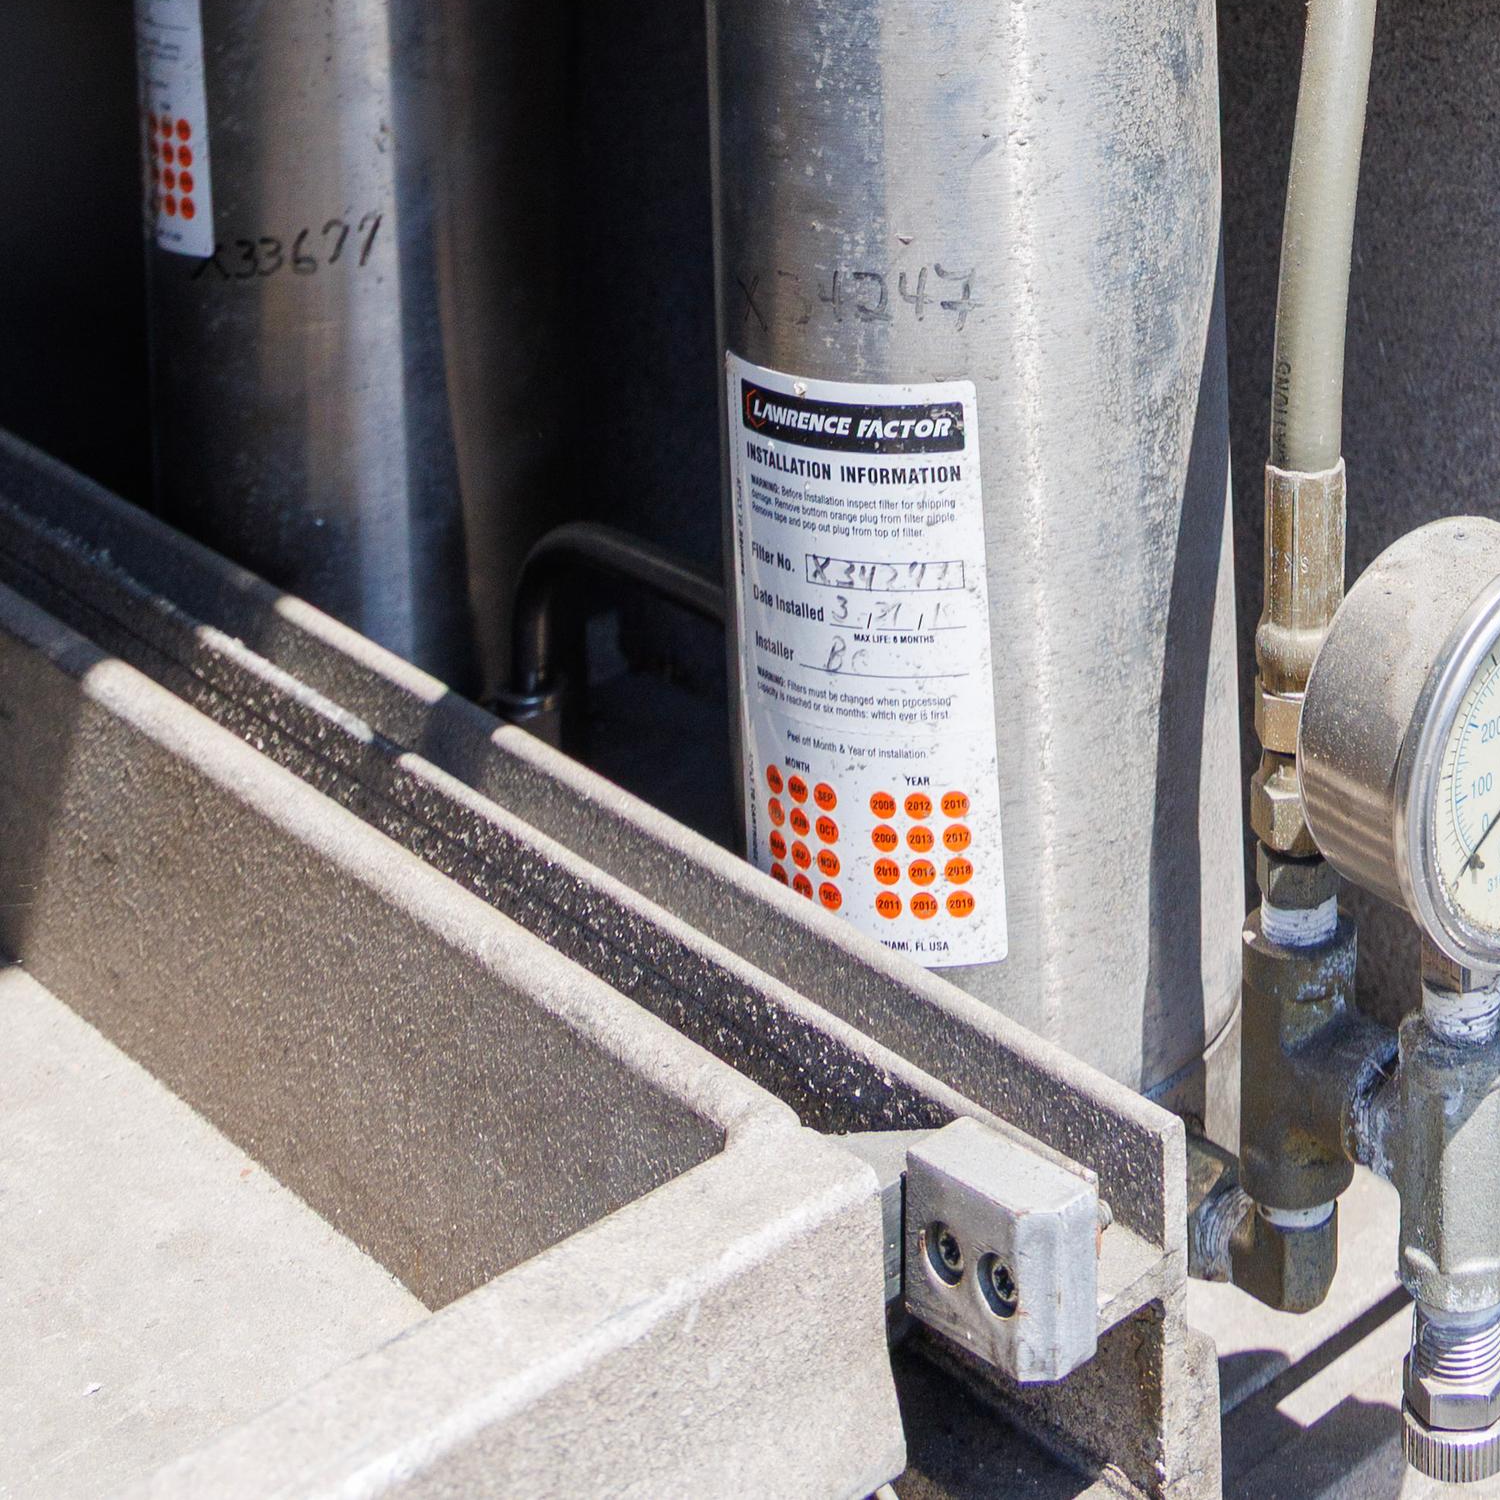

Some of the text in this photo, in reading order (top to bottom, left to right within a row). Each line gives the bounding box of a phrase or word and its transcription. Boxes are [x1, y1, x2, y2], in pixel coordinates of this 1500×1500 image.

[753, 398, 952, 440] LAWRENCE FACTOR
[746, 440, 962, 485] INSTALLATION INFORMATION
[781, 485, 803, 501] Before
[846, 498, 877, 512] inspect
[879, 498, 898, 511] filter
[901, 498, 914, 511] for
[916, 498, 956, 512] shipping
[801, 503, 828, 520] bottom
[829, 510, 858, 524] orange
[859, 511, 878, 526] plug
[880, 512, 901, 524] from
[903, 511, 923, 524] filter
[801, 519, 817, 534] pop
[818, 520, 831, 534] out
[832, 521, 850, 537] plug
[851, 524, 873, 537] from
[874, 525, 889, 539] top
[751, 540, 796, 573] Filter No.
[753, 584, 825, 623] Date Installed
[755, 629, 795, 662] Installer
[853, 633, 870, 644] MAX
[872, 634, 891, 645] LIFE:
[899, 634, 935, 645] MONTHS
[786, 679, 807, 696] Filters
[808, 687, 827, 699] must
[829, 689, 838, 701] be
[839, 692, 874, 708] changed
[876, 695, 900, 706] when
[901, 696, 952, 709] processing
[822, 703, 835, 714] six
[870, 710, 897, 721] which
[812, 737, 838, 752] Month
[838, 743, 846, 754] &
[847, 744, 865, 757] Year
[867, 746, 877, 757] of
[784, 755, 811, 774] MONTH
[905, 775, 931, 787] YEAR
[1471, 771, 1494, 799] 100
[872, 799, 896, 812] 2008
[906, 800, 931, 812] 2012
[943, 798, 968, 810] 2016
[818, 823, 836, 837] OCT
[945, 831, 970, 844] 2017
[873, 832, 898, 844] 2009
[908, 833, 933, 845] 2013
[820, 855, 838, 870] NOV
[946, 864, 972, 877] 2018
[877, 899, 901, 911] 2011
[948, 898, 974, 910] 2019
[915, 941, 926, 952] FL
[928, 940, 950, 952] USA
